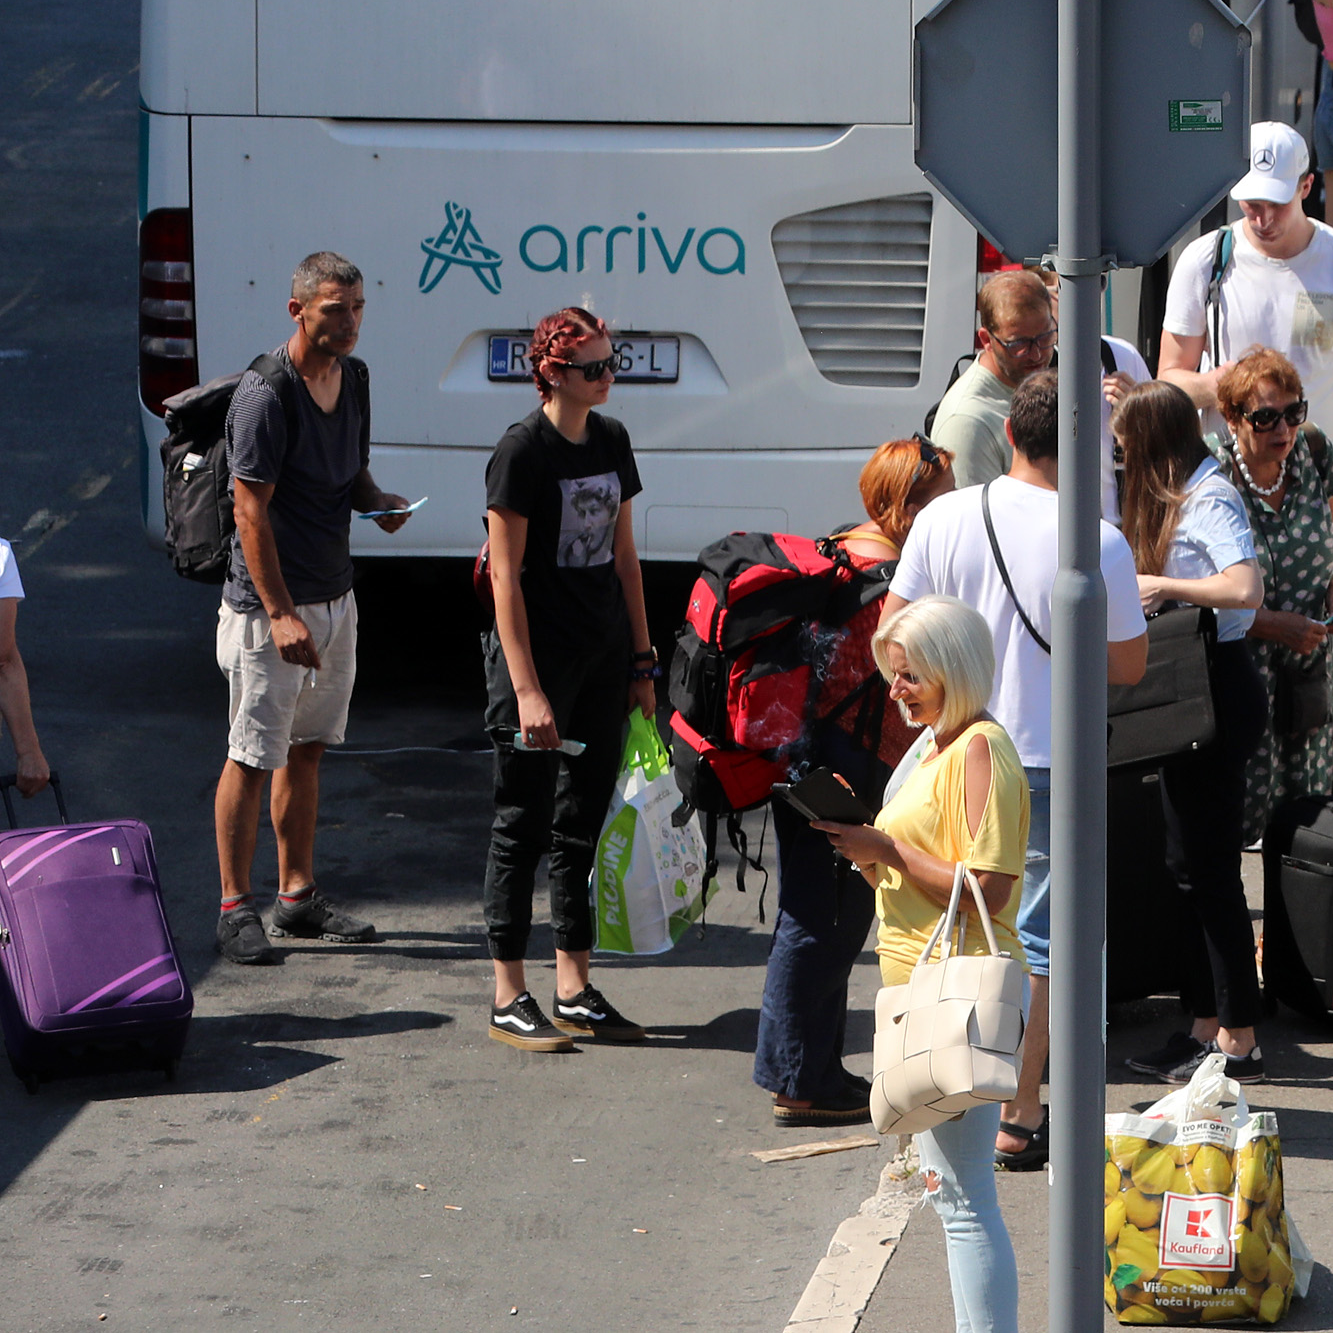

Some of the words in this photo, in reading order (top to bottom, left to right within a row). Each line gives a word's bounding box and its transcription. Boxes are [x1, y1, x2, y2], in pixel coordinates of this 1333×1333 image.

[518, 211, 746, 276] arriva
[492, 358, 507, 369] HR
[604, 829, 629, 928] PLODINE
[1170, 1241, 1225, 1256] Kaufland
[1143, 1280, 1168, 1294] Više
[1171, 1283, 1187, 1295] od
[1189, 1283, 1213, 1296] 200
[1215, 1285, 1247, 1296] vrsta
[1155, 1295, 1184, 1307] voća
[1192, 1296, 1236, 1309] povrća
